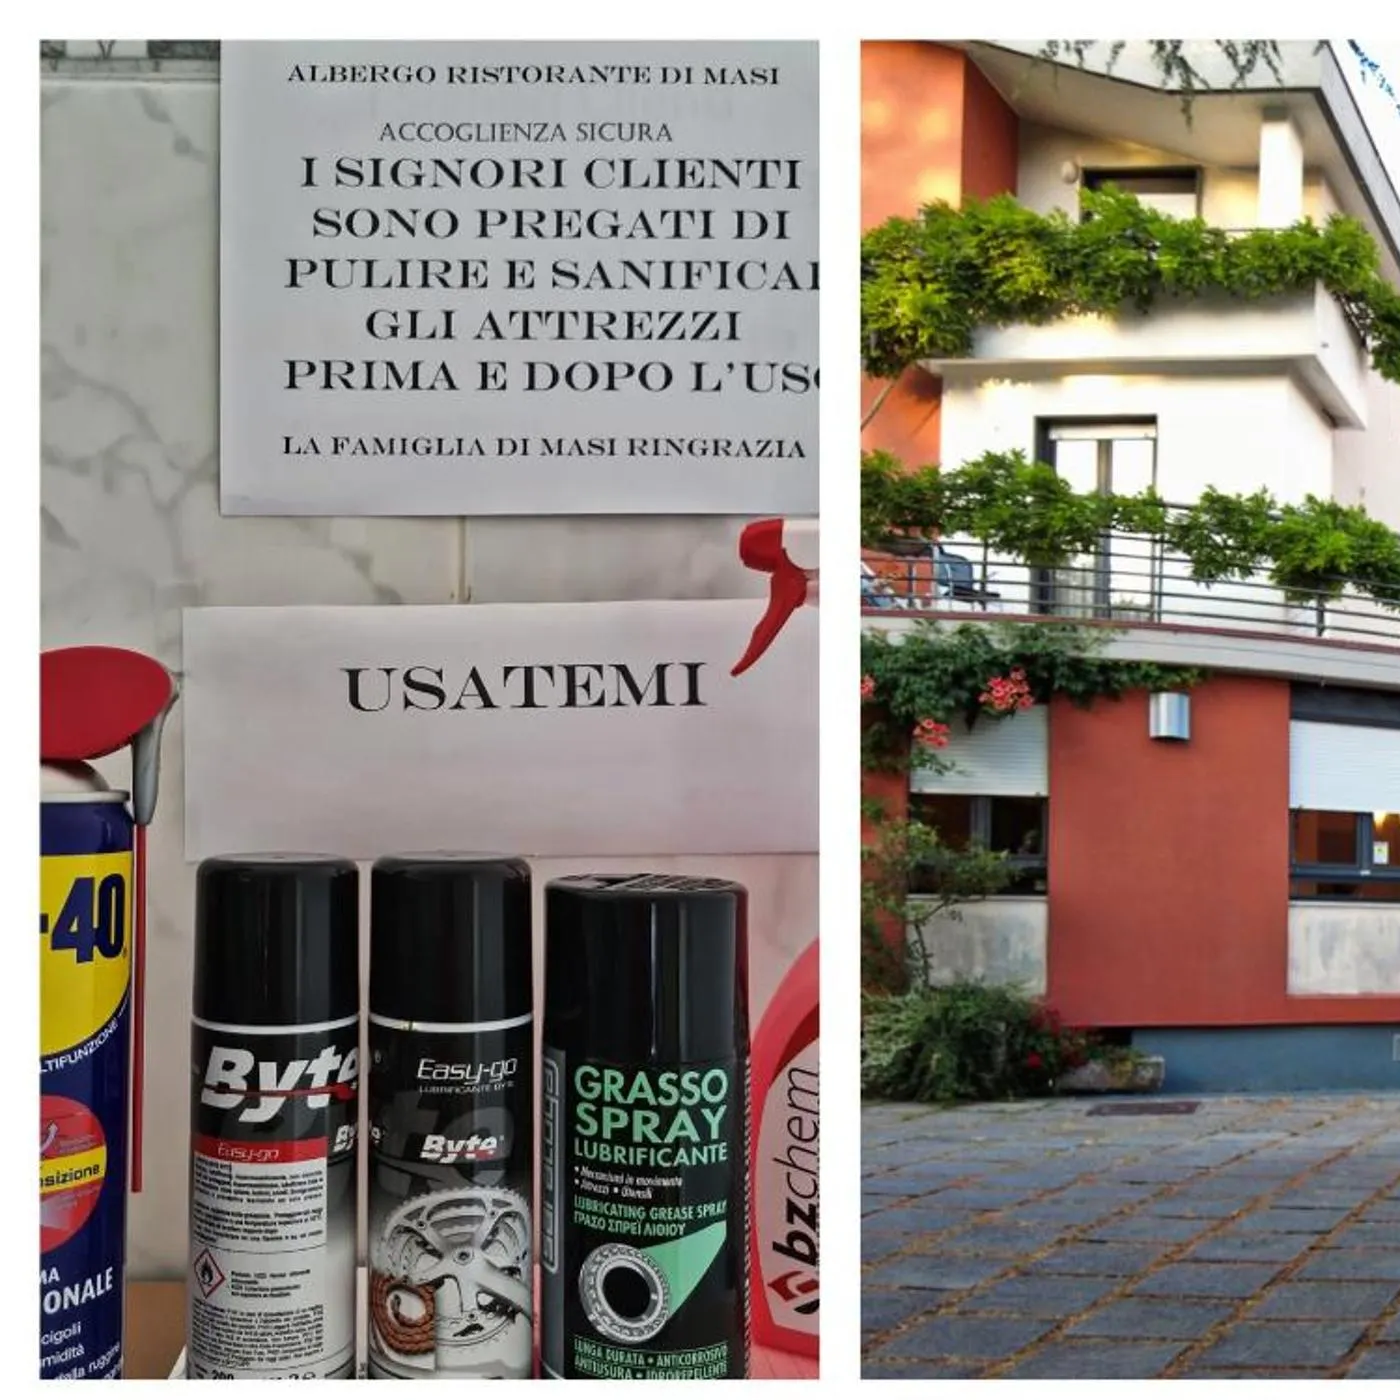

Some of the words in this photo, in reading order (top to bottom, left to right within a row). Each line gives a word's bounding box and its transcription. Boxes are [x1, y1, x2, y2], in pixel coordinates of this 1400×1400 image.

[288, 65, 436, 85] ALBERGO
[447, 66, 651, 85] RISTORANTE
[661, 66, 693, 85] DI
[703, 67, 780, 86] MASI
[379, 122, 567, 143] ACCOGLIENZA
[576, 122, 673, 143] SICURA
[301, 158, 318, 189] I
[335, 157, 565, 190] SIGNORI
[584, 158, 804, 190] CLIENTI
[313, 208, 459, 239] SONO
[476, 209, 716, 240] PREGATI
[735, 210, 791, 240] DI
[284, 259, 489, 289] PULIRE
[506, 260, 535, 289] E
[365, 309, 457, 341] GLI
[473, 310, 742, 341] ATTREZZI
[284, 359, 460, 391] PRIMA
[476, 361, 507, 391] E
[523, 361, 673, 393] DOPO
[691, 361, 820, 393] L'US
[282, 436, 321, 456] LA
[332, 437, 487, 457] FAMIGLIA
[498, 438, 531, 457] DI
[541, 438, 616, 457] MASI
[628, 438, 807, 459] RINGRAZIA
[338, 662, 708, 712] USATEMI
[417, 1057, 519, 1087] Easy-go
[574, 1065, 728, 1106] GRASSO
[575, 1102, 727, 1143] SPRAY
[420, 1134, 498, 1163] Byte
[574, 1137, 727, 1168] LUBRIFICANTE
[772, 1066, 820, 1267] bzchem
[574, 1194, 646, 1220] LUBRICATING
[649, 1206, 693, 1219] GREASE
